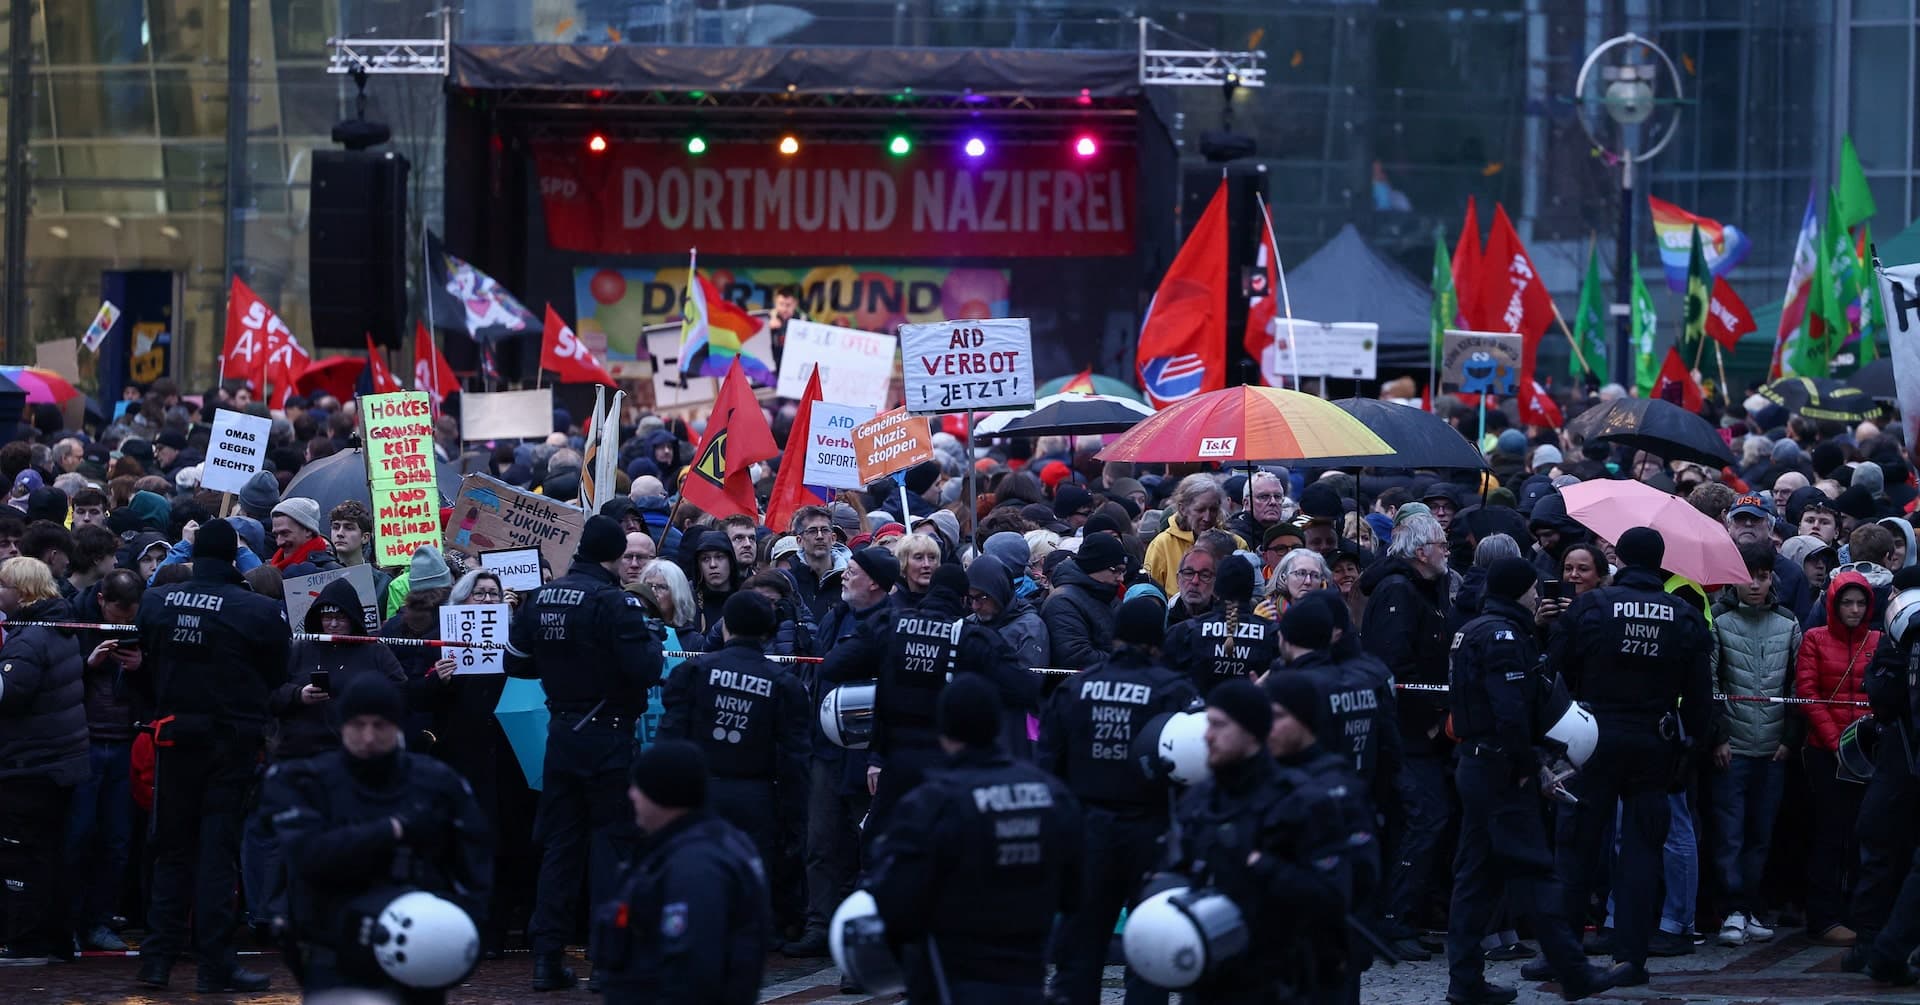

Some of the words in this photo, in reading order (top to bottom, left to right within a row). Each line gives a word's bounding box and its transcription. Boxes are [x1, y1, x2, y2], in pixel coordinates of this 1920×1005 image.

[540, 176, 578, 197] SPD
[622, 167, 897, 231] DORTMUND
[913, 168, 1126, 232] NAZIFREI
[949, 328, 984, 349] AfD
[921, 352, 1019, 376] VERBOT
[371, 398, 430, 420] HÖCKES
[828, 415, 855, 429] AfD
[225, 428, 256, 442] OMAS
[873, 426, 907, 450] Nazis
[219, 441, 256, 456] GEGEN
[384, 438, 421, 455] KEIT
[867, 438, 917, 466] stoppen
[213, 457, 255, 473] RECHTS
[390, 488, 426, 503] UND
[513, 495, 560, 523] Welche
[503, 509, 570, 545] ZUKUNFT
[164, 591, 223, 611] POLIZEI
[536, 588, 585, 605] POLIZEI
[540, 613, 566, 626] NRW
[1613, 601, 1674, 621] POLIZEI
[177, 614, 200, 628] NRW
[173, 628, 202, 644] 2741
[1625, 623, 1660, 639] NRW
[905, 641, 940, 658] NRW
[1621, 639, 1659, 656] 2712
[905, 657, 935, 672] 2712
[1214, 661, 1245, 675] 2712
[709, 668, 773, 697] POLIZEI
[1080, 681, 1151, 705] POLIZEI
[715, 694, 752, 713] NRW
[715, 710, 749, 729] 2712
[1092, 705, 1131, 723] NRW
[1095, 723, 1130, 740] 2741
[1344, 717, 1372, 736] NRW
[1092, 742, 1128, 760] BeSi
